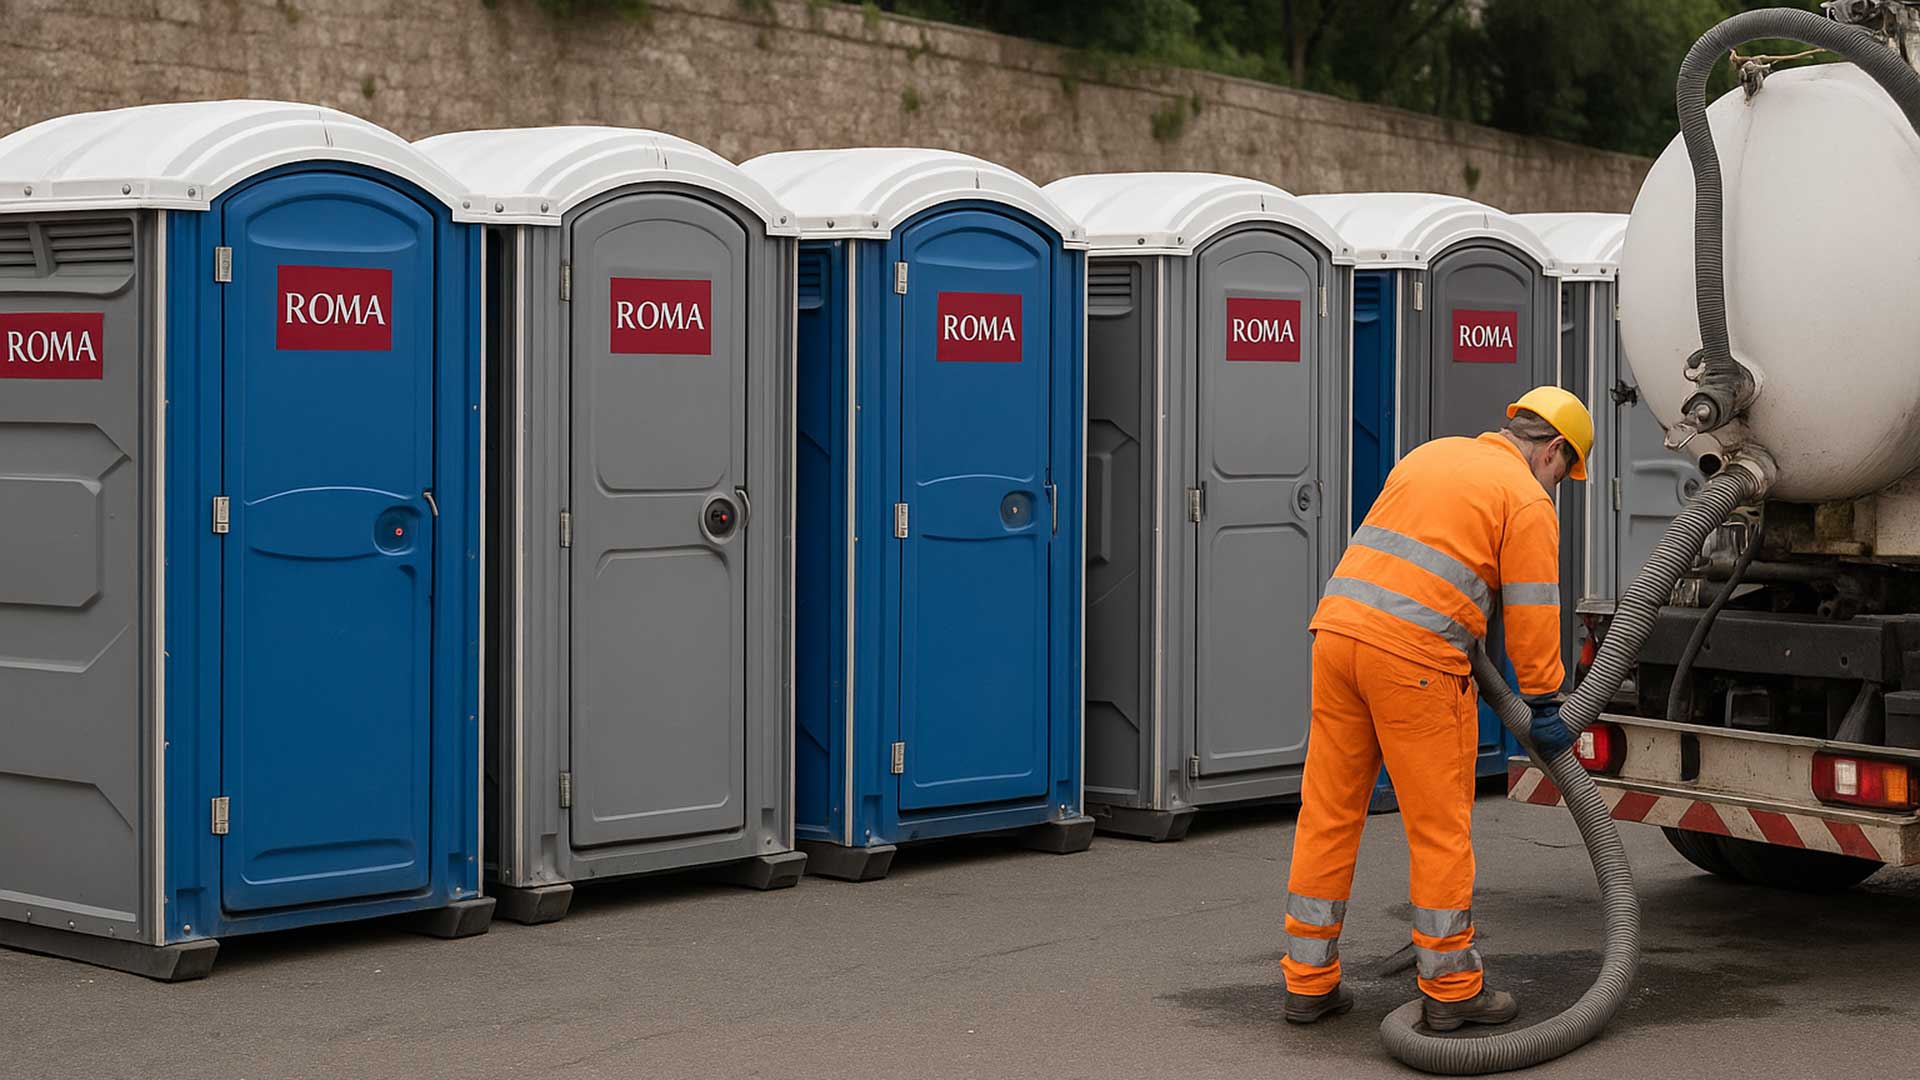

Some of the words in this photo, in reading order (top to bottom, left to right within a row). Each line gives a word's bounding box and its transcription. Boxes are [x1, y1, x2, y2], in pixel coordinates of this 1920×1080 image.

[285, 292, 386, 325] ROMA
[616, 301, 705, 331] ROMA
[943, 314, 1016, 342] ROMA
[1233, 318, 1295, 343] ROMA
[1458, 324, 1513, 348] ROMA
[7, 330, 97, 363] ROMA
